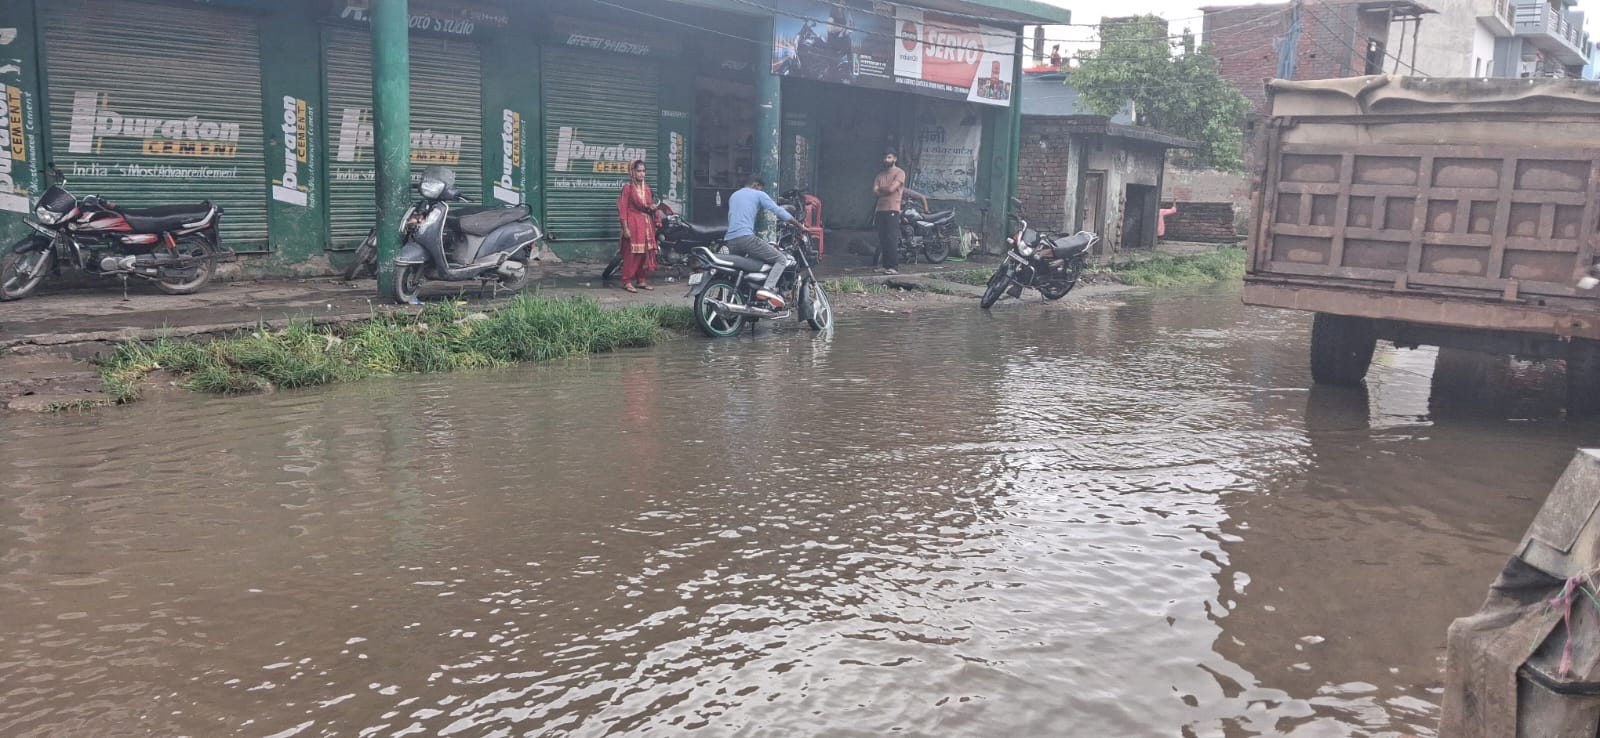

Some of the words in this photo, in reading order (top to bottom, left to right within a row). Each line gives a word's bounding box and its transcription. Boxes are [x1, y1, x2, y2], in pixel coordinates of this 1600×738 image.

[925, 31, 978, 65] SERVO
[8, 91, 23, 156] CEMENT
[297, 103, 306, 159] CEMENT
[146, 142, 236, 156] CEMENT
